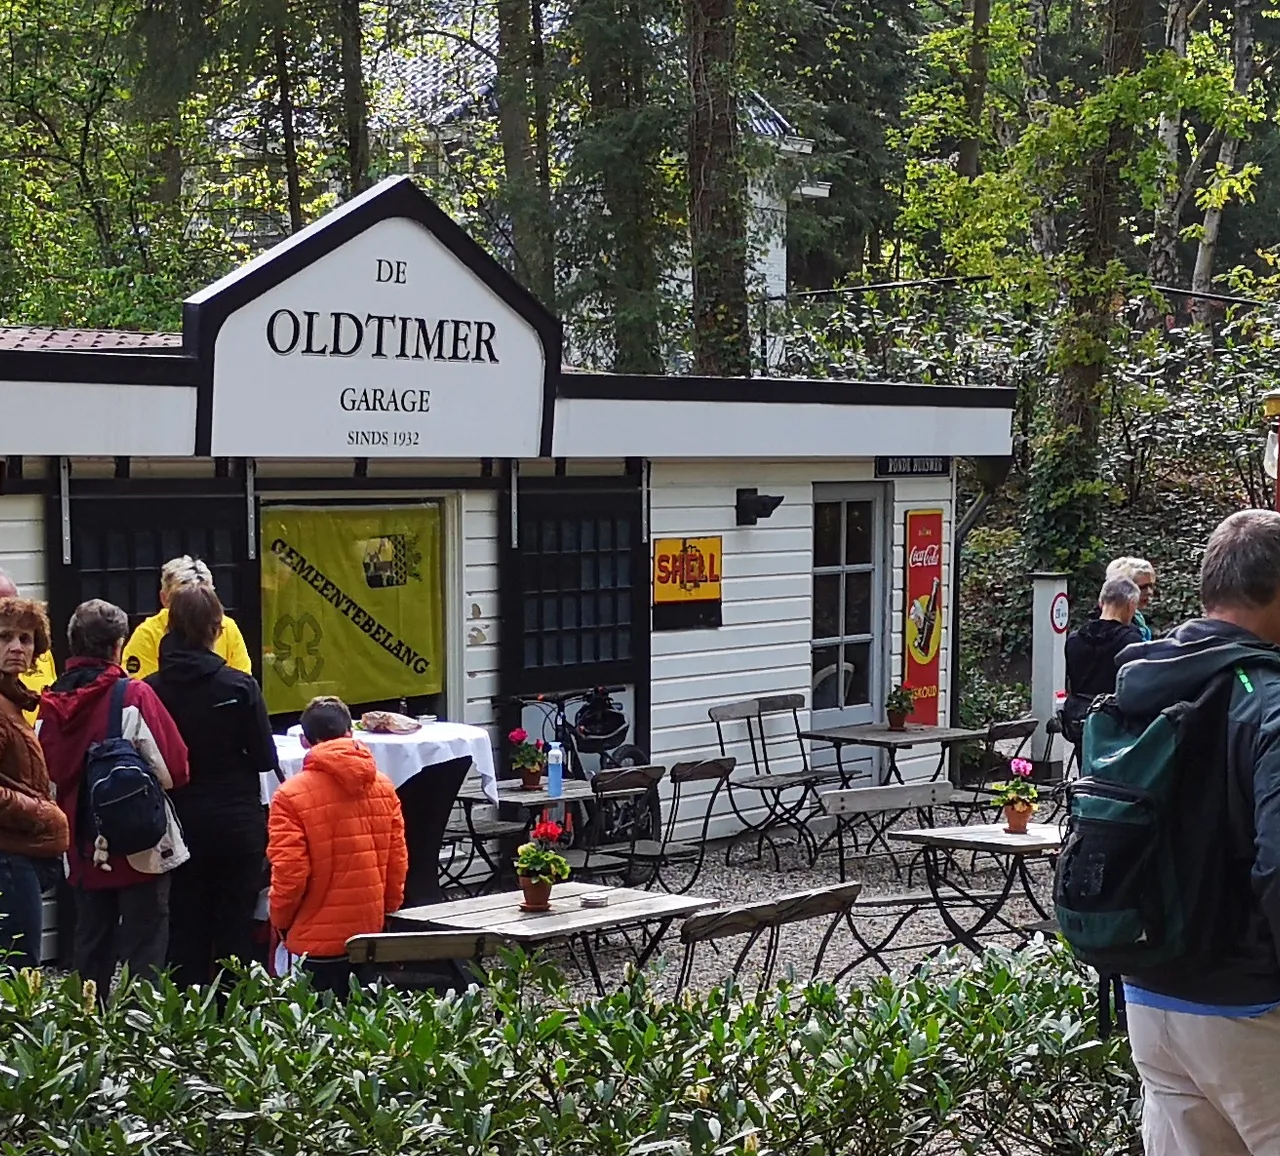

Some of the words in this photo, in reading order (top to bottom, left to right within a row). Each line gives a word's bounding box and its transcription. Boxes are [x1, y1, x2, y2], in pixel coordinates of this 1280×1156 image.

[375, 258, 407, 285] DE
[266, 308, 500, 364] OLDTIMER
[339, 387, 431, 413] GARAGE
[346, 430, 389, 446] SINDS
[392, 431, 420, 446] 1932
[656, 553, 720, 584] SHELL
[270, 538, 430, 675] GEMEENTEBELANG
